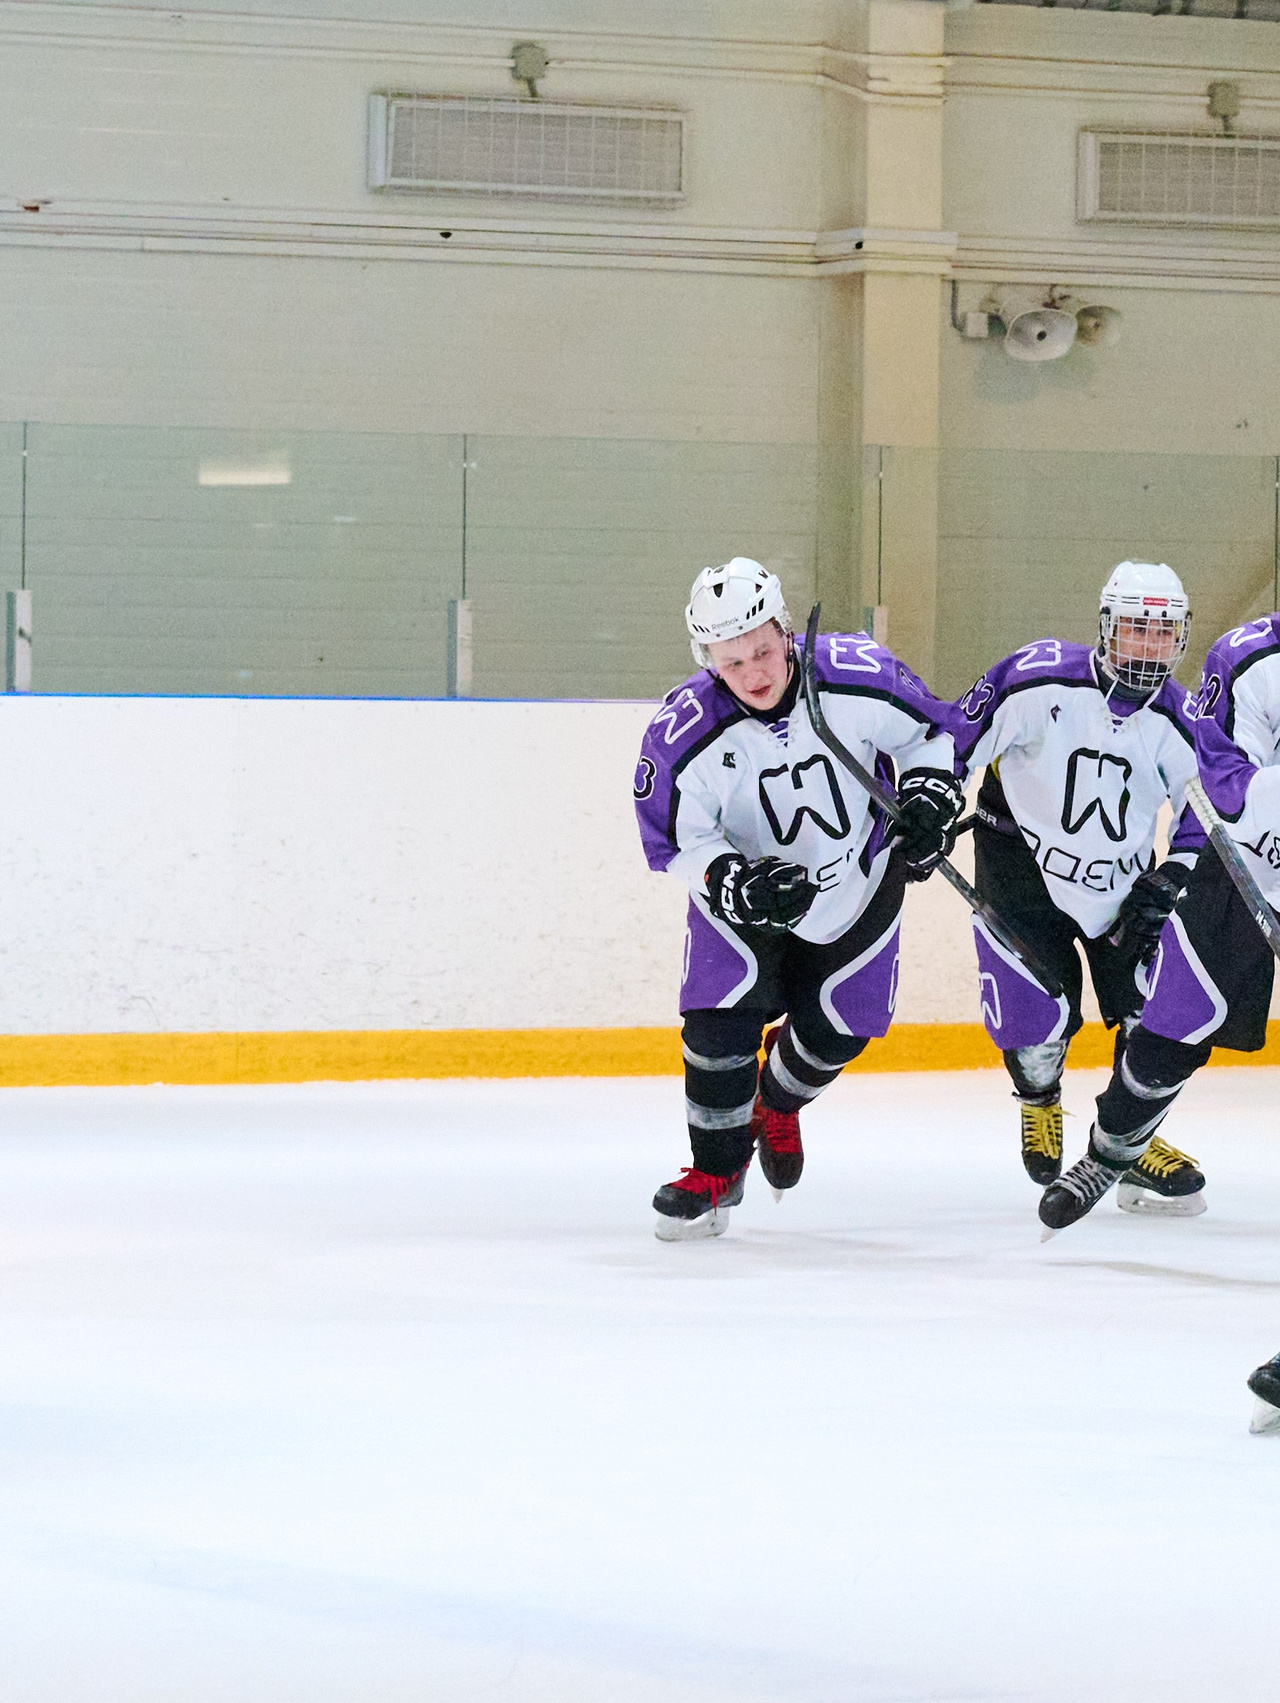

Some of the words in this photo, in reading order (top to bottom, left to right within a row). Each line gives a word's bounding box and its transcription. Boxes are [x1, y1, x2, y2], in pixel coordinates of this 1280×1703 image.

[711, 616, 740, 631] Reebok
[902, 776, 963, 812] CCM
[721, 861, 744, 924] CCM
